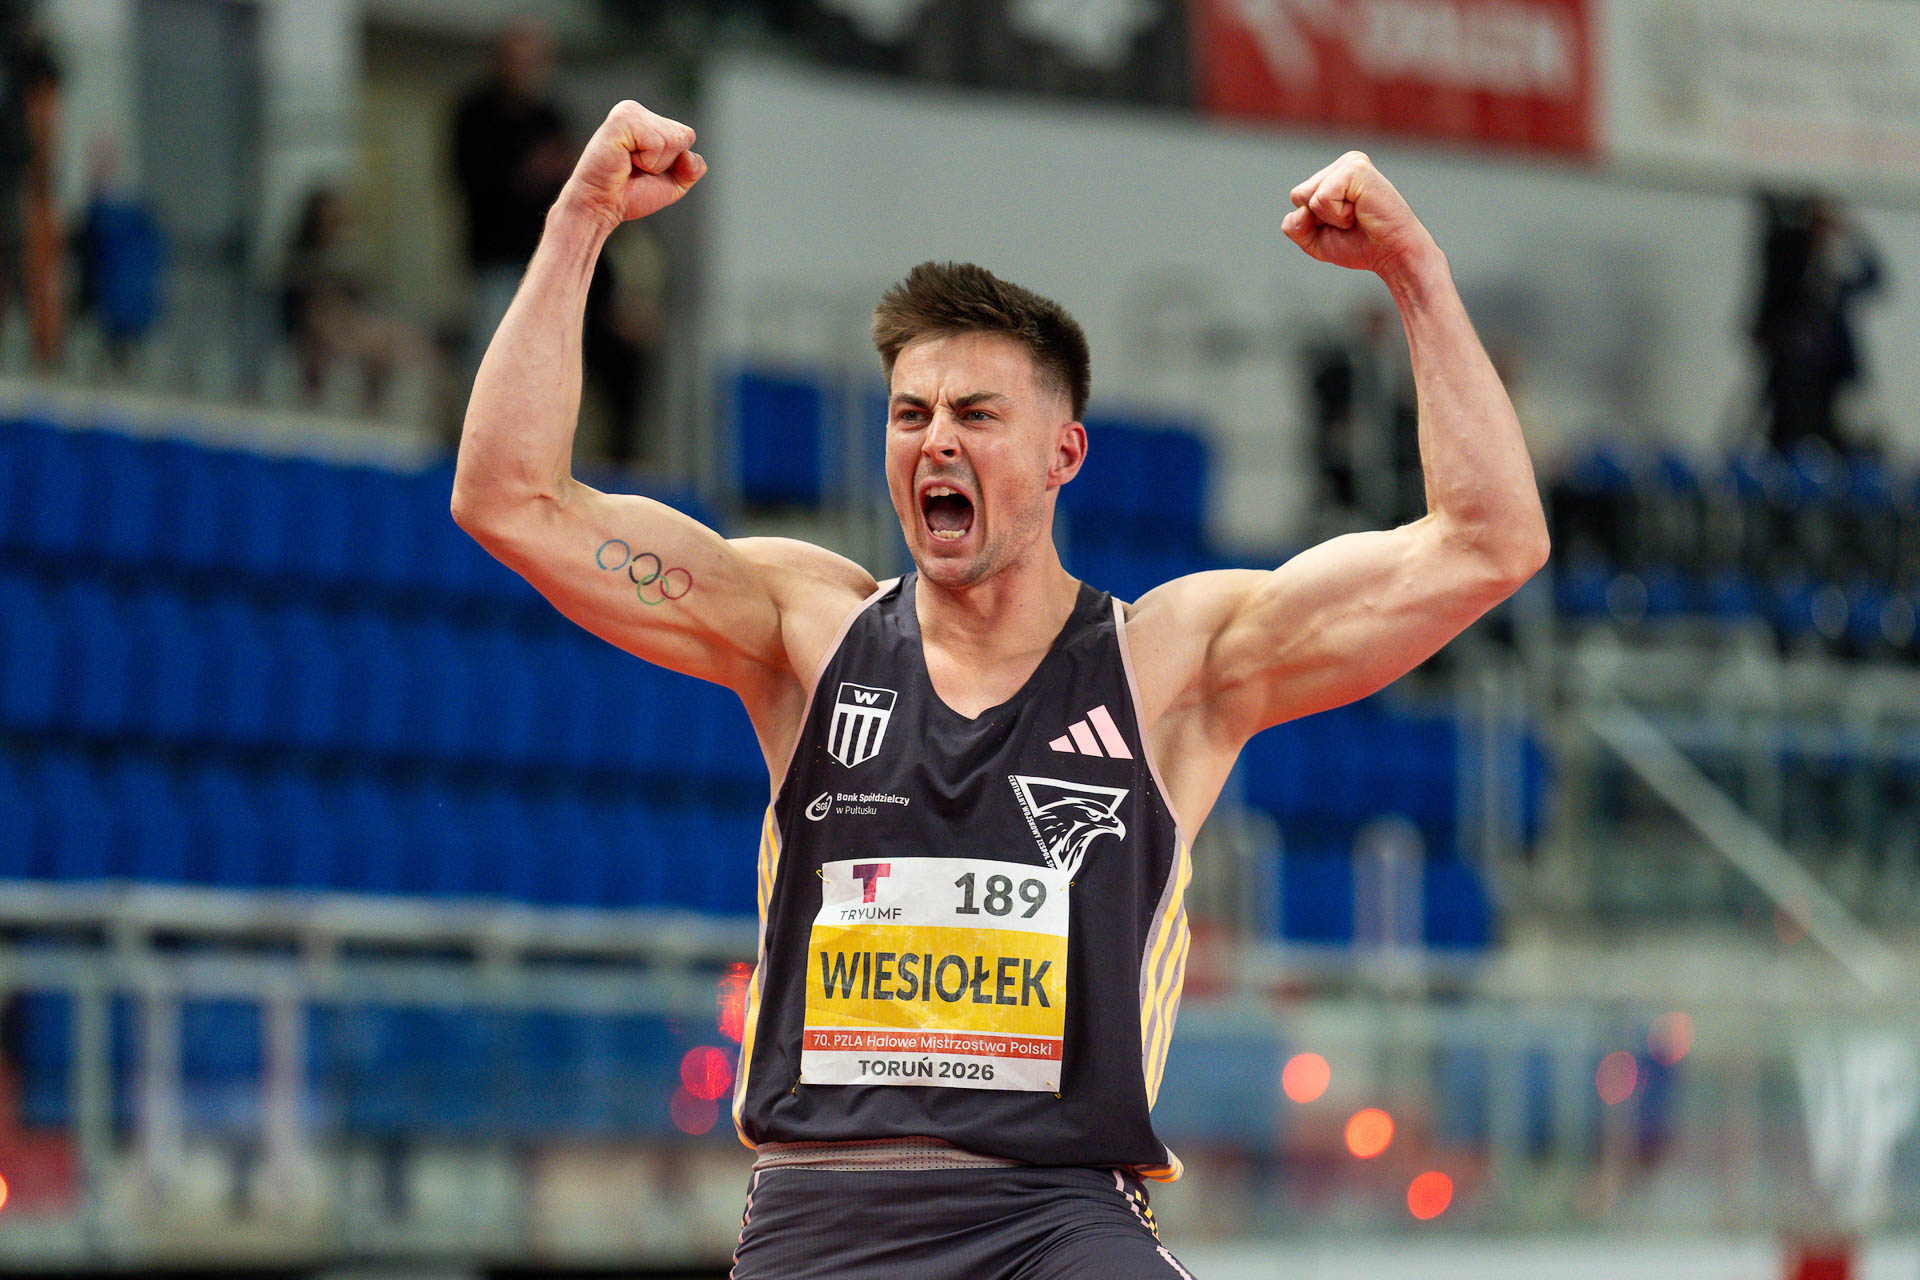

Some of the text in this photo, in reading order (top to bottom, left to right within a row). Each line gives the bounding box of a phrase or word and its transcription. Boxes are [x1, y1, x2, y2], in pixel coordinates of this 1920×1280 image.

[836, 792, 910, 806] Bank Spółdzielczy
[845, 805, 877, 815] Pułtusku
[1022, 805, 1042, 840] WOJSKOWY
[954, 872, 1047, 919] 189
[840, 907, 903, 921] TRYUMF
[820, 951, 1053, 1008] WIESIOŁEK
[813, 1034, 1053, 1056] 70. PZLA Halowe Mistrzostwa Polski
[859, 1057, 994, 1081] TORUŃ 2026
